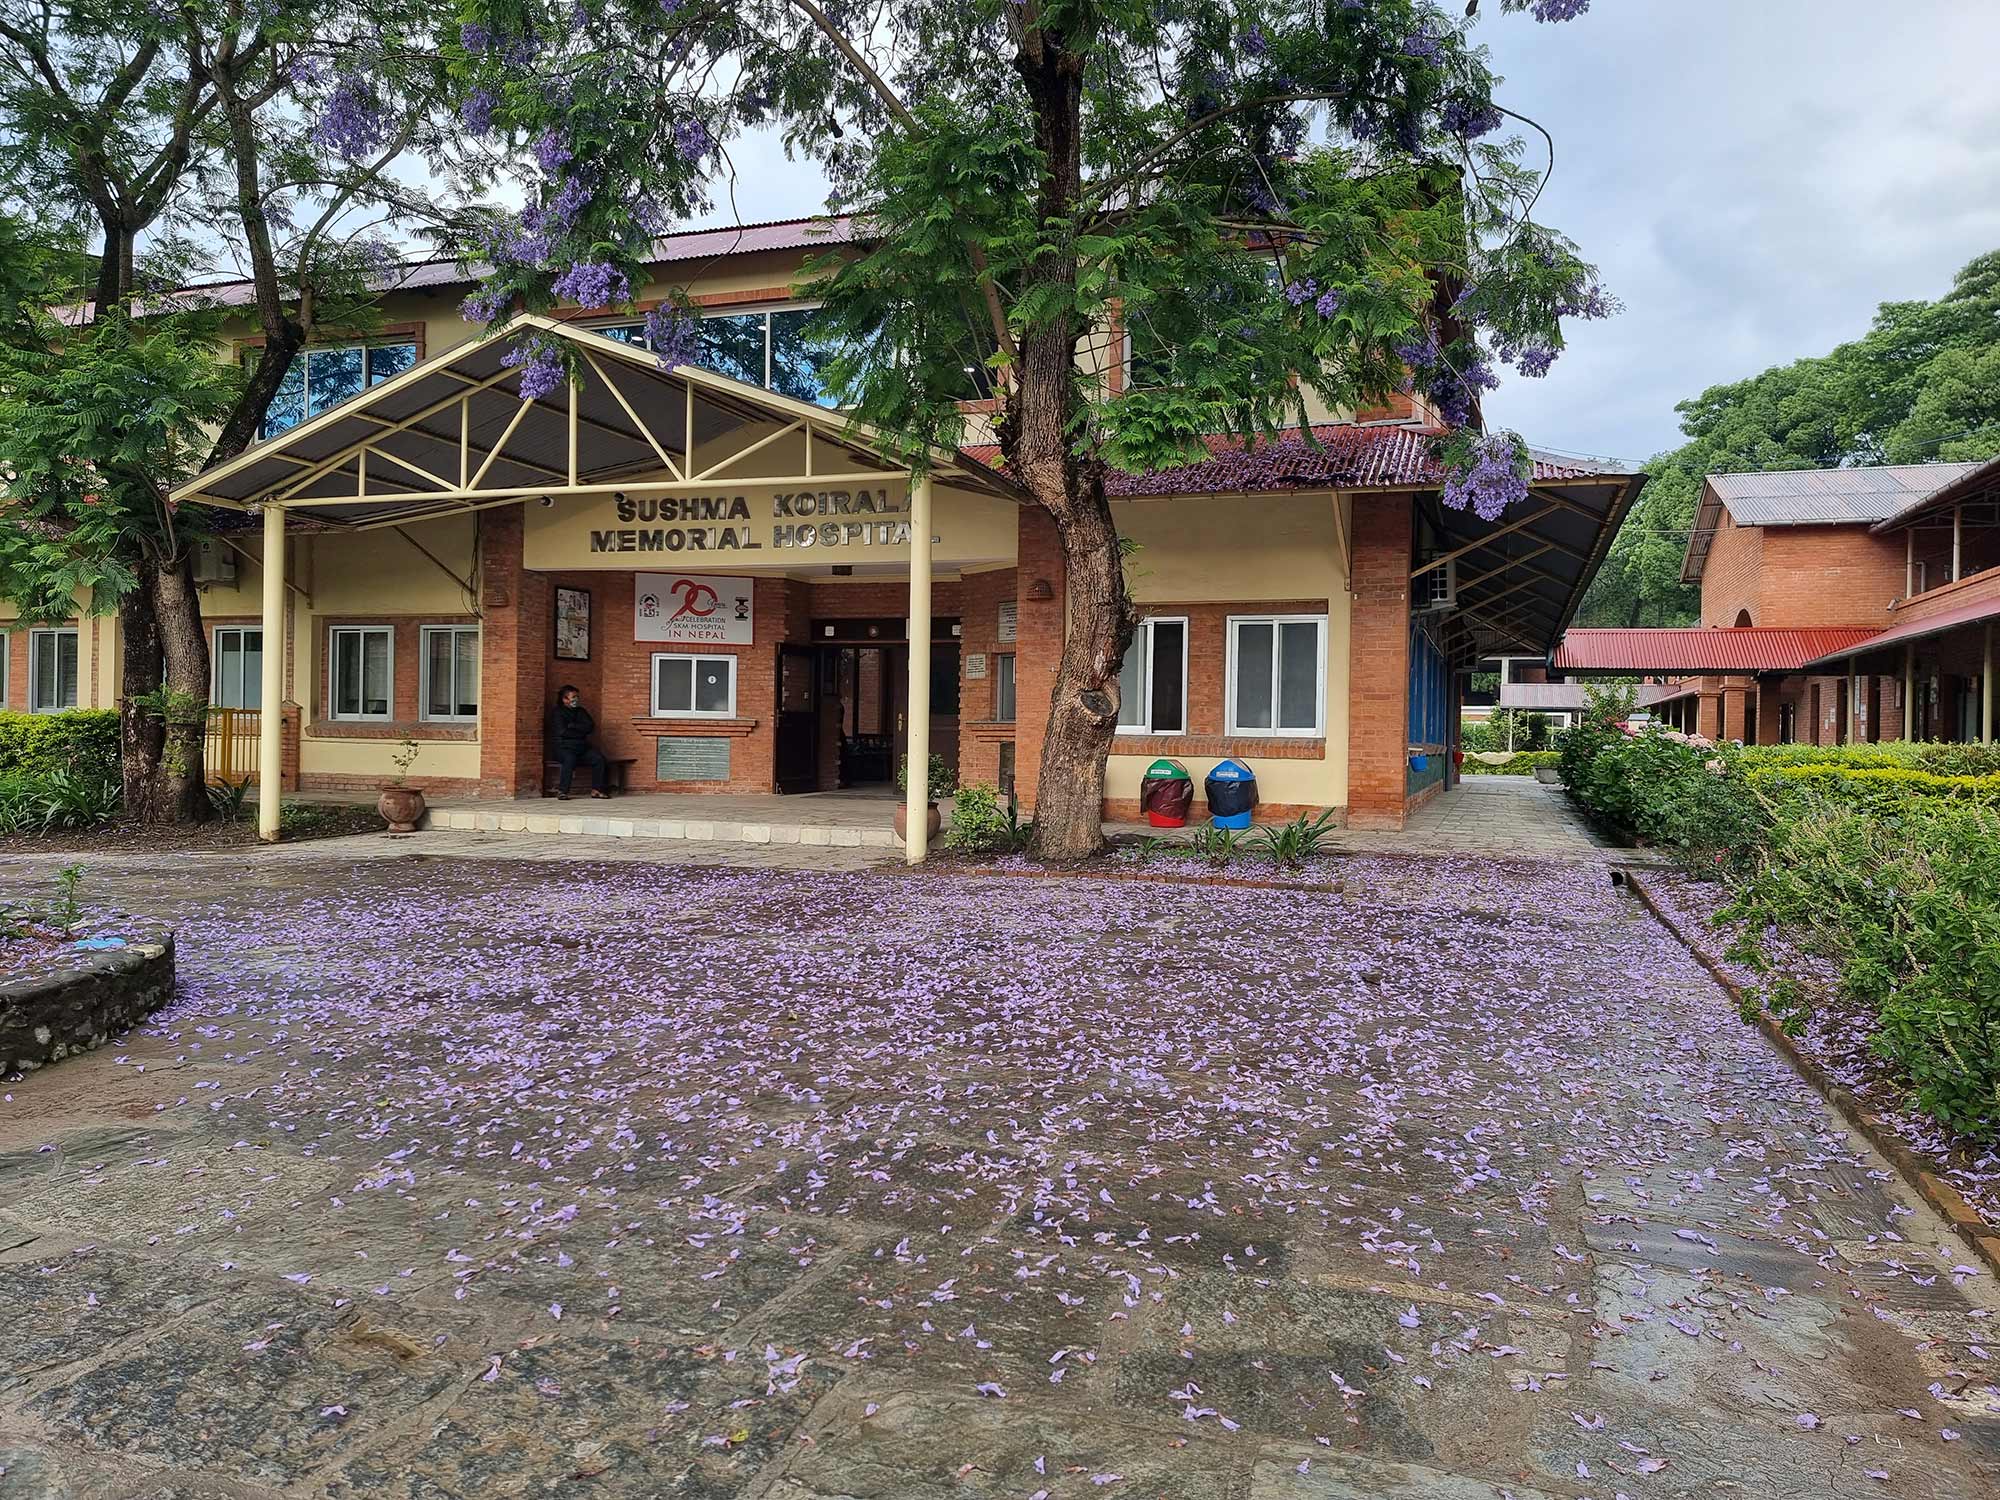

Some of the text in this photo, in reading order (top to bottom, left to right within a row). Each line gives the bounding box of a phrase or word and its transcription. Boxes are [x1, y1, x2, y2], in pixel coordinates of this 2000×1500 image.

[617, 496, 751, 523] SUSHMA
[590, 520, 941, 552] MEMORIAL HOSPITA
[671, 579, 718, 618] 20
[673, 622, 689, 630] SKM
[691, 623, 726, 631] HOSPITAL
[686, 616, 726, 624] CELEBRATION
[668, 630, 726, 640] IN NEPAL
